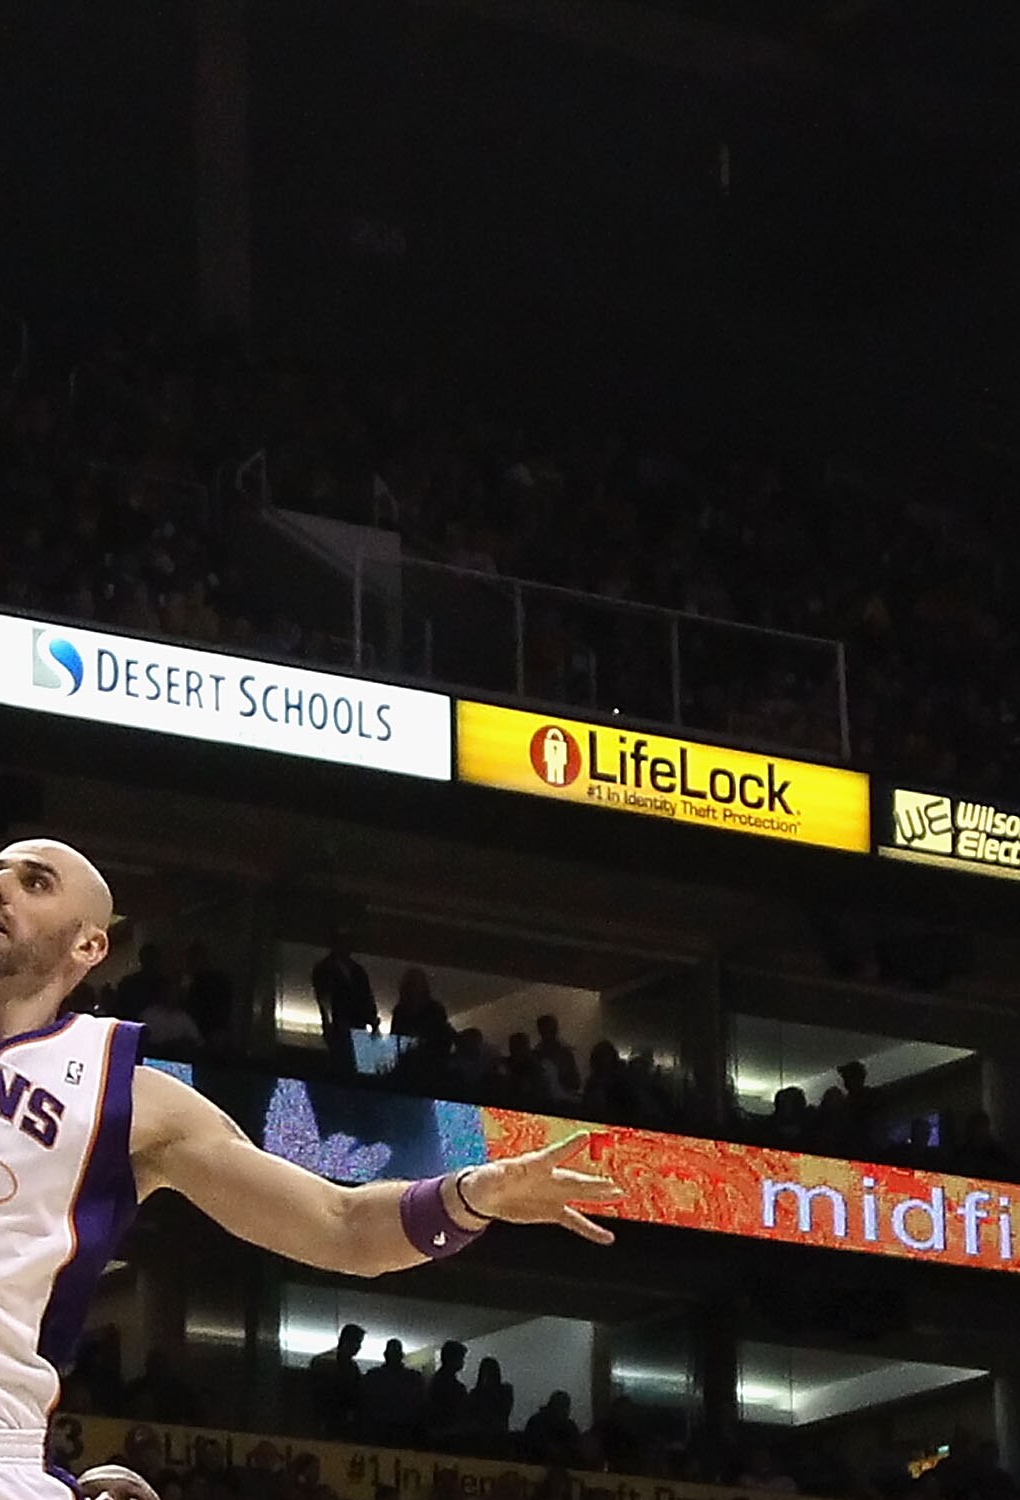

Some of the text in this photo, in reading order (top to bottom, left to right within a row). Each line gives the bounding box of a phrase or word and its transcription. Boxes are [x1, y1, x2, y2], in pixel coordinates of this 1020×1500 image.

[97, 648, 392, 741] DESERT SCHOOLS
[624, 791, 678, 817] Identity
[681, 800, 719, 821] Theft
